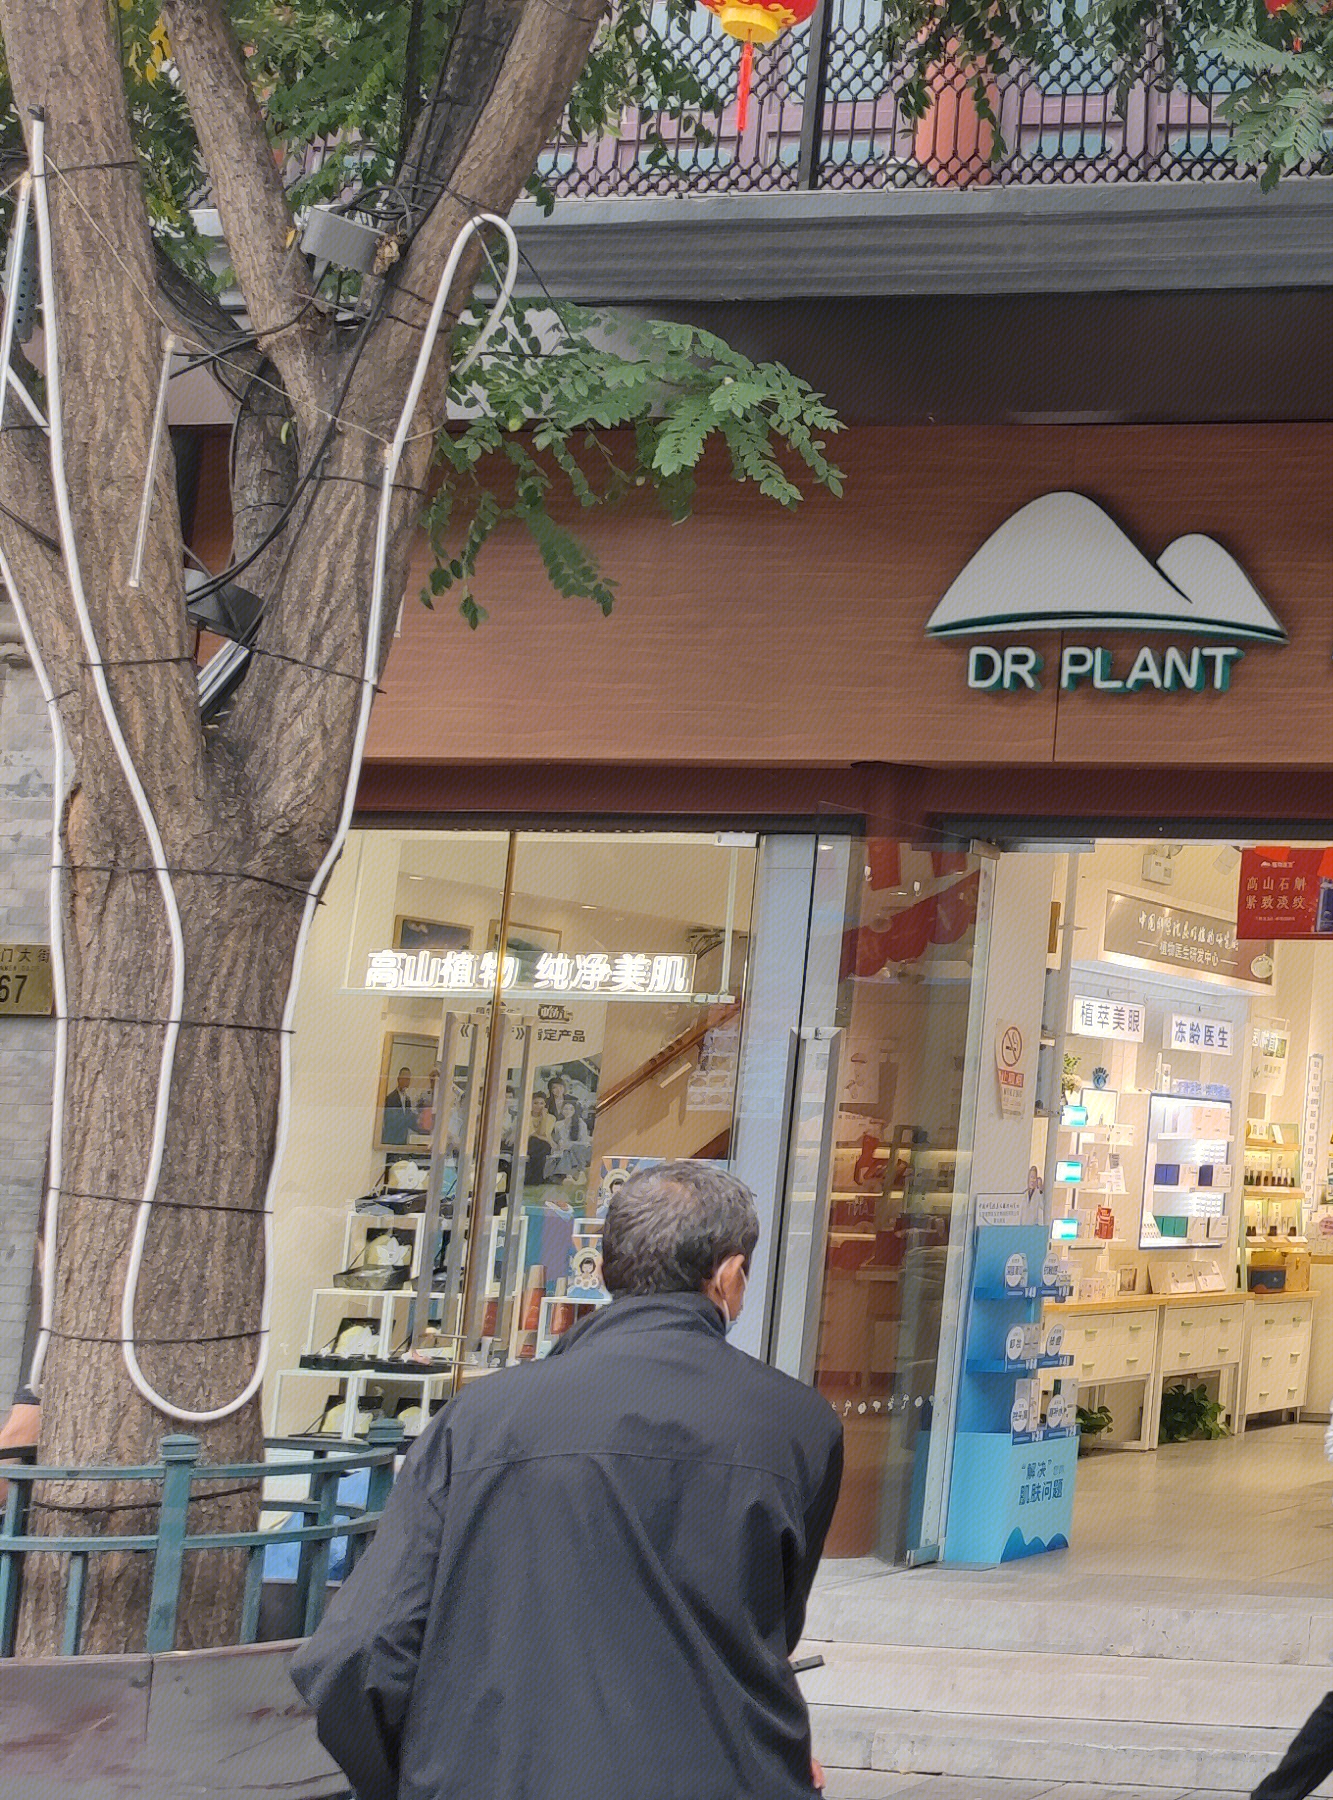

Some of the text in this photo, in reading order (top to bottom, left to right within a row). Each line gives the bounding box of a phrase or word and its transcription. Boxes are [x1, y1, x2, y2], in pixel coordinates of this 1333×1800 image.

[967, 648, 1241, 692] DR PLANT
[1246, 876, 1307, 892] 高山石斛
[1245, 894, 1307, 911] 紧致淡纹
[365, 949, 690, 993] 高山植物 纯净美肌
[1080, 1000, 1141, 1033] 植萃美眼
[1174, 1019, 1229, 1050] 冻龄医生
[1019, 1478, 1064, 1506] 肌肤问题
